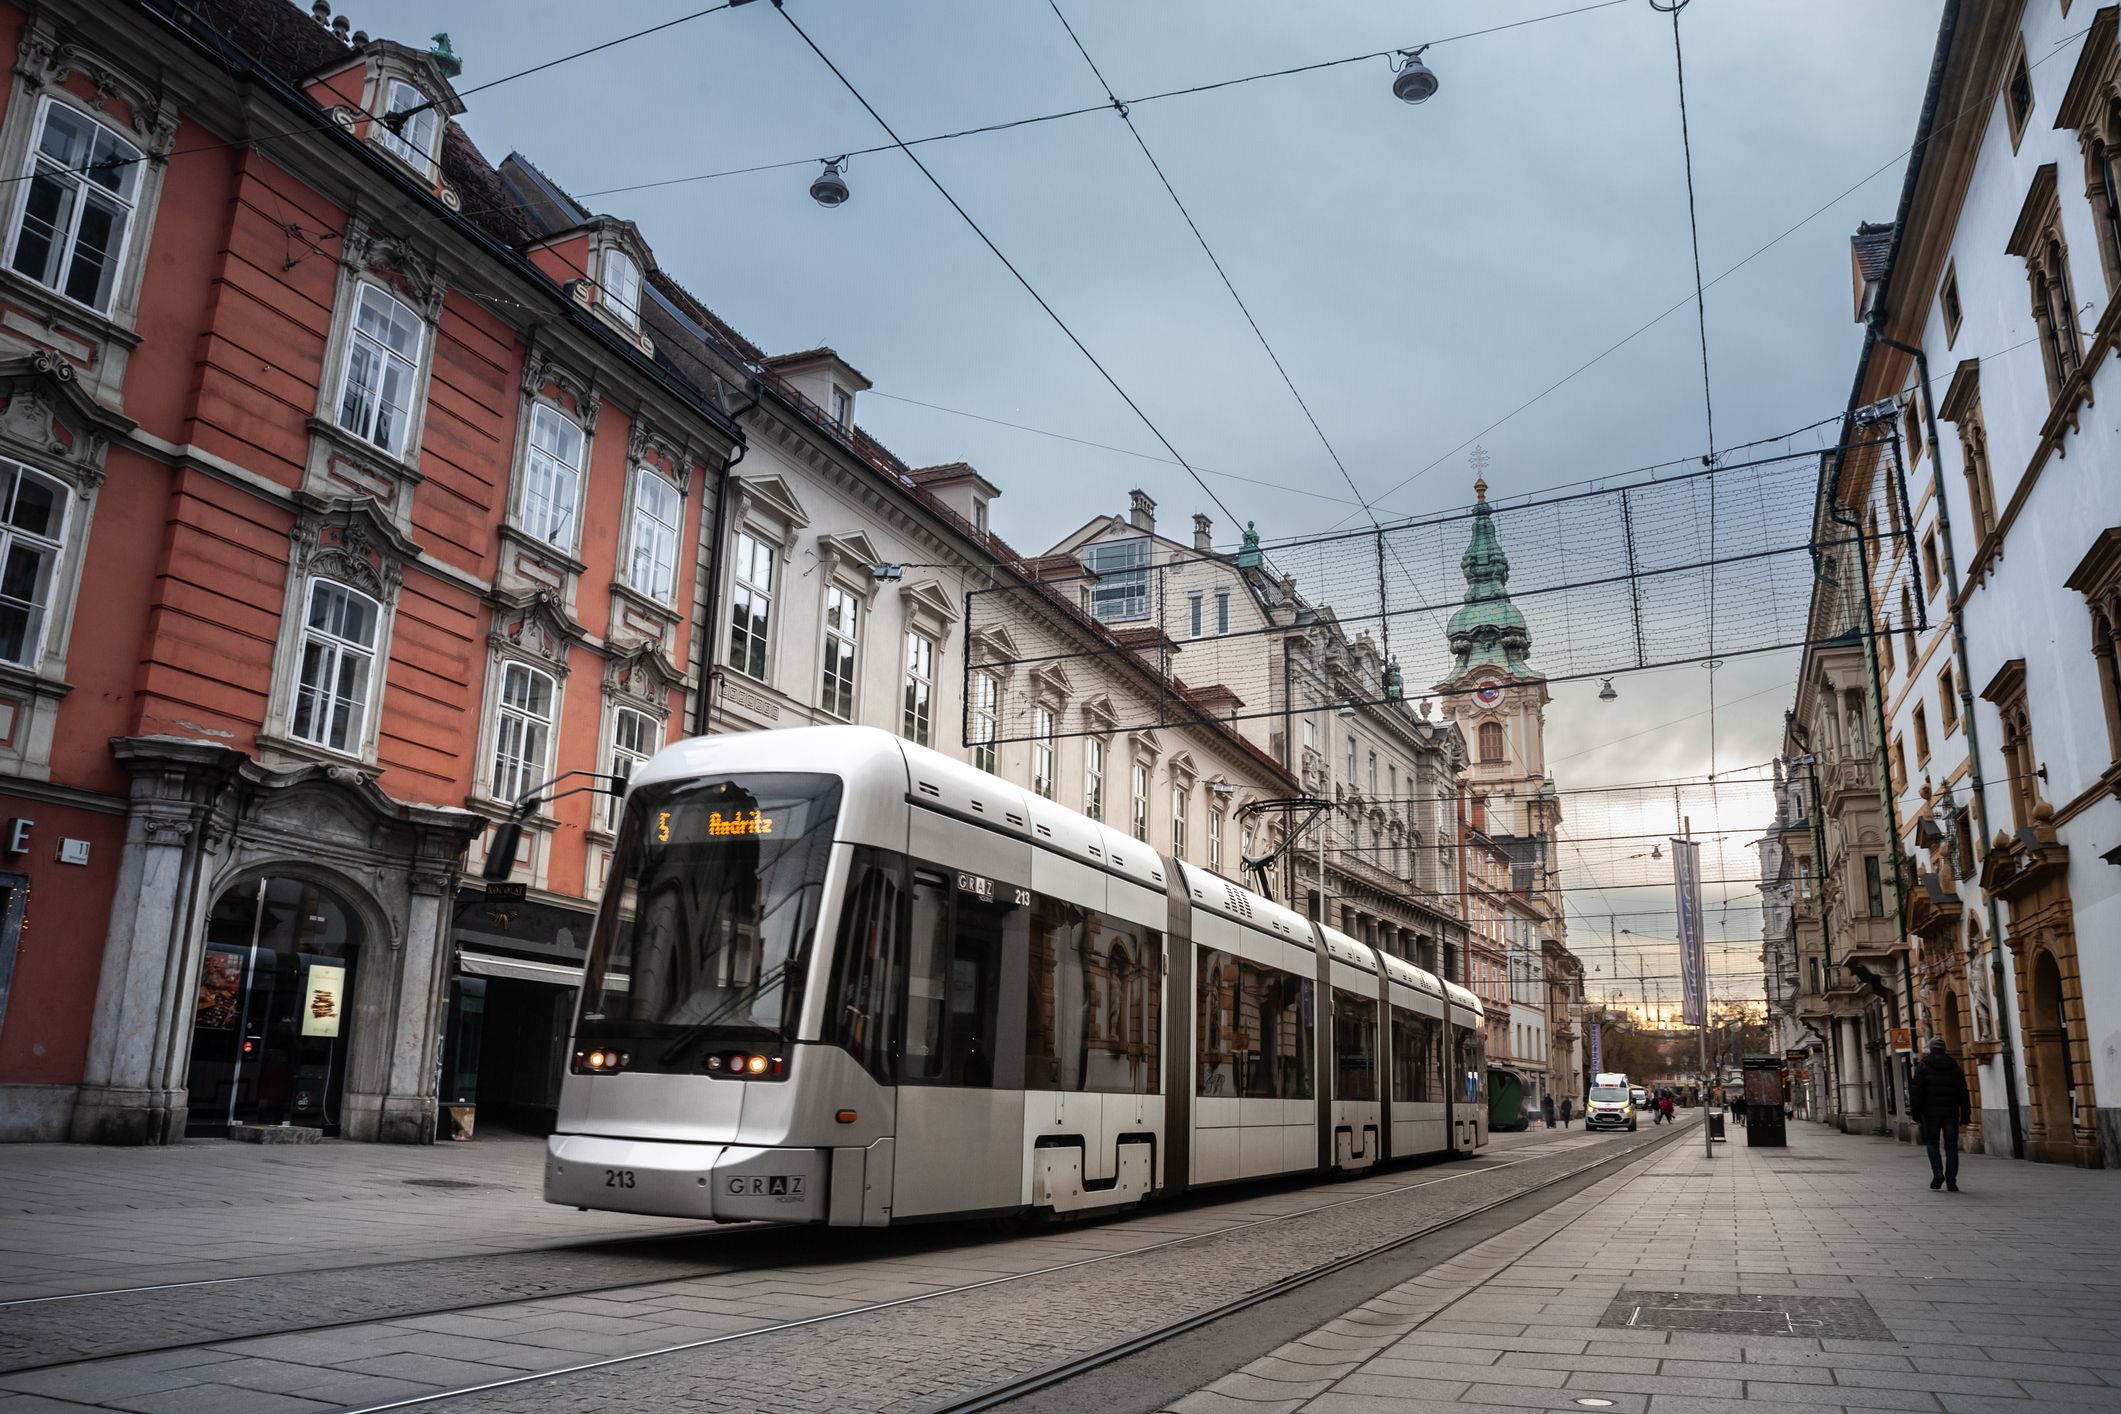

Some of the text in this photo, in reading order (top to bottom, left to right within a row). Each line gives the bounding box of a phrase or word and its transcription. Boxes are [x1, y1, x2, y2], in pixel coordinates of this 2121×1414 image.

[11, 818, 34, 853] E
[658, 810, 773, 841] 5 Andritz
[80, 842, 89, 855] 11
[959, 874, 993, 896] GRAZ
[1015, 889, 1031, 906] 213
[605, 1169, 636, 1189] 213
[728, 1177, 803, 1194] GRAZ
